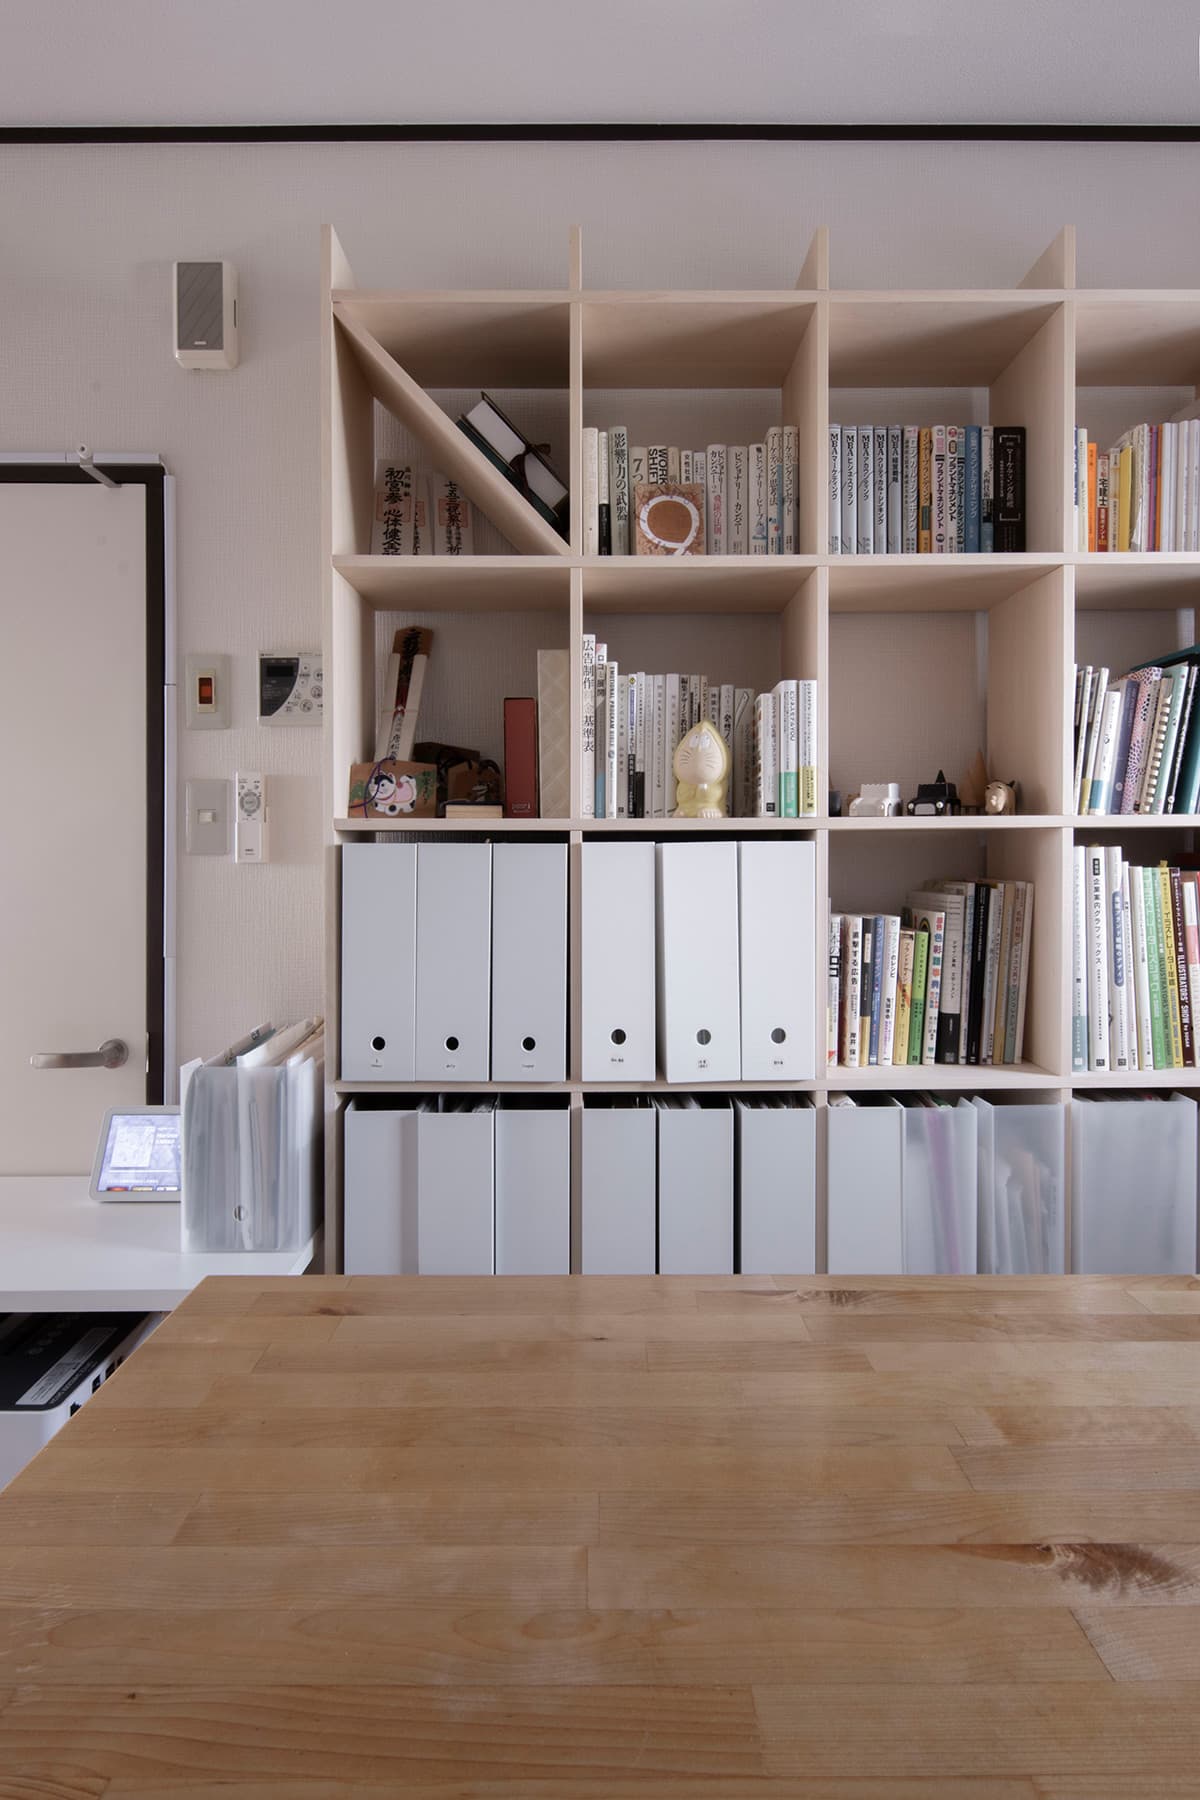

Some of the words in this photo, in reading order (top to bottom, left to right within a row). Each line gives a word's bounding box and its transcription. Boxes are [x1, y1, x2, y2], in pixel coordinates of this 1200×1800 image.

[614, 433, 628, 521] 影響力の武器
[658, 448, 668, 485] WORK
[1093, 877, 1101, 964] 企業案内グラフィックス
[1177, 954, 1187, 1003] ILLUSTRATORS'
